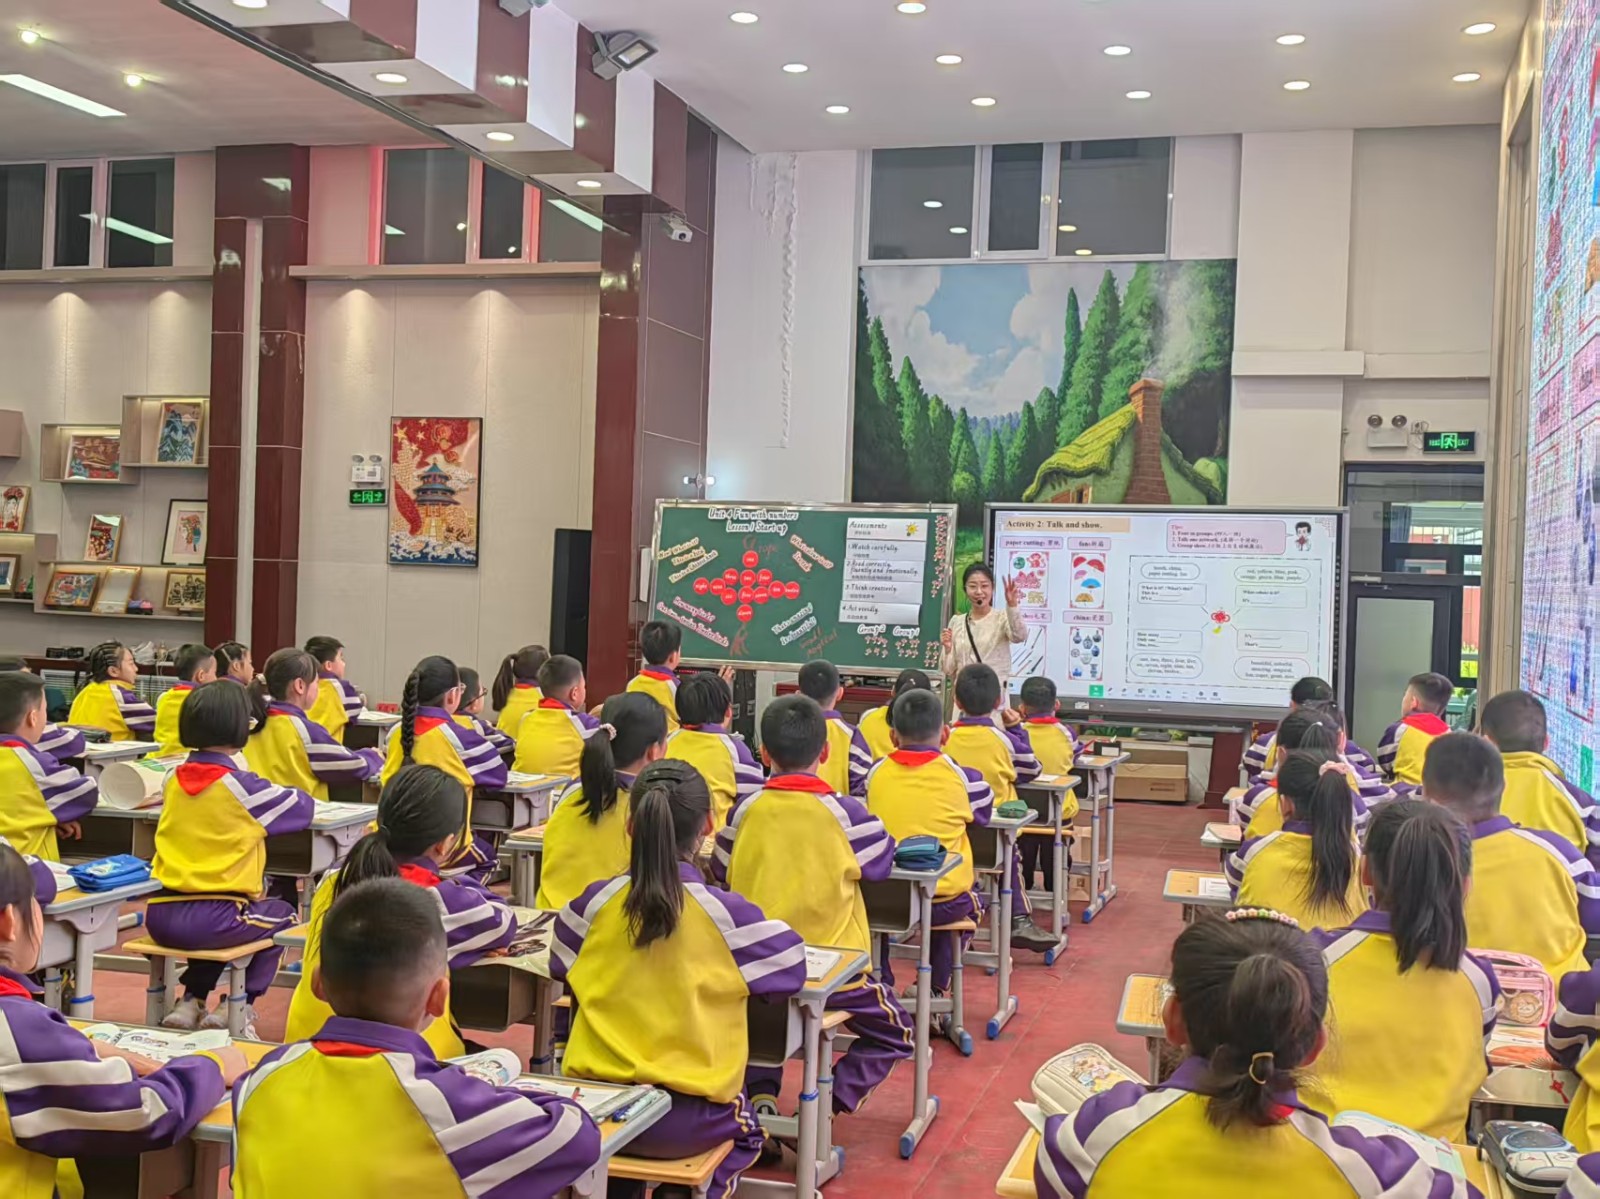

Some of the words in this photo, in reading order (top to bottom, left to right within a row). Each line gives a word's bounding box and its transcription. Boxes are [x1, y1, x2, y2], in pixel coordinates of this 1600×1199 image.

[709, 508, 725, 518] Unit
[726, 509, 732, 519] 4
[734, 508, 749, 520] Fun
[751, 508, 768, 519] with
[768, 508, 798, 520] numbers
[727, 521, 749, 532] Lesson
[756, 521, 776, 532] Start
[777, 524, 787, 536] up
[849, 521, 887, 529] Assessments
[1007, 520, 1035, 528] Activity
[858, 624, 878, 636] Group
[893, 626, 914, 638] Group
